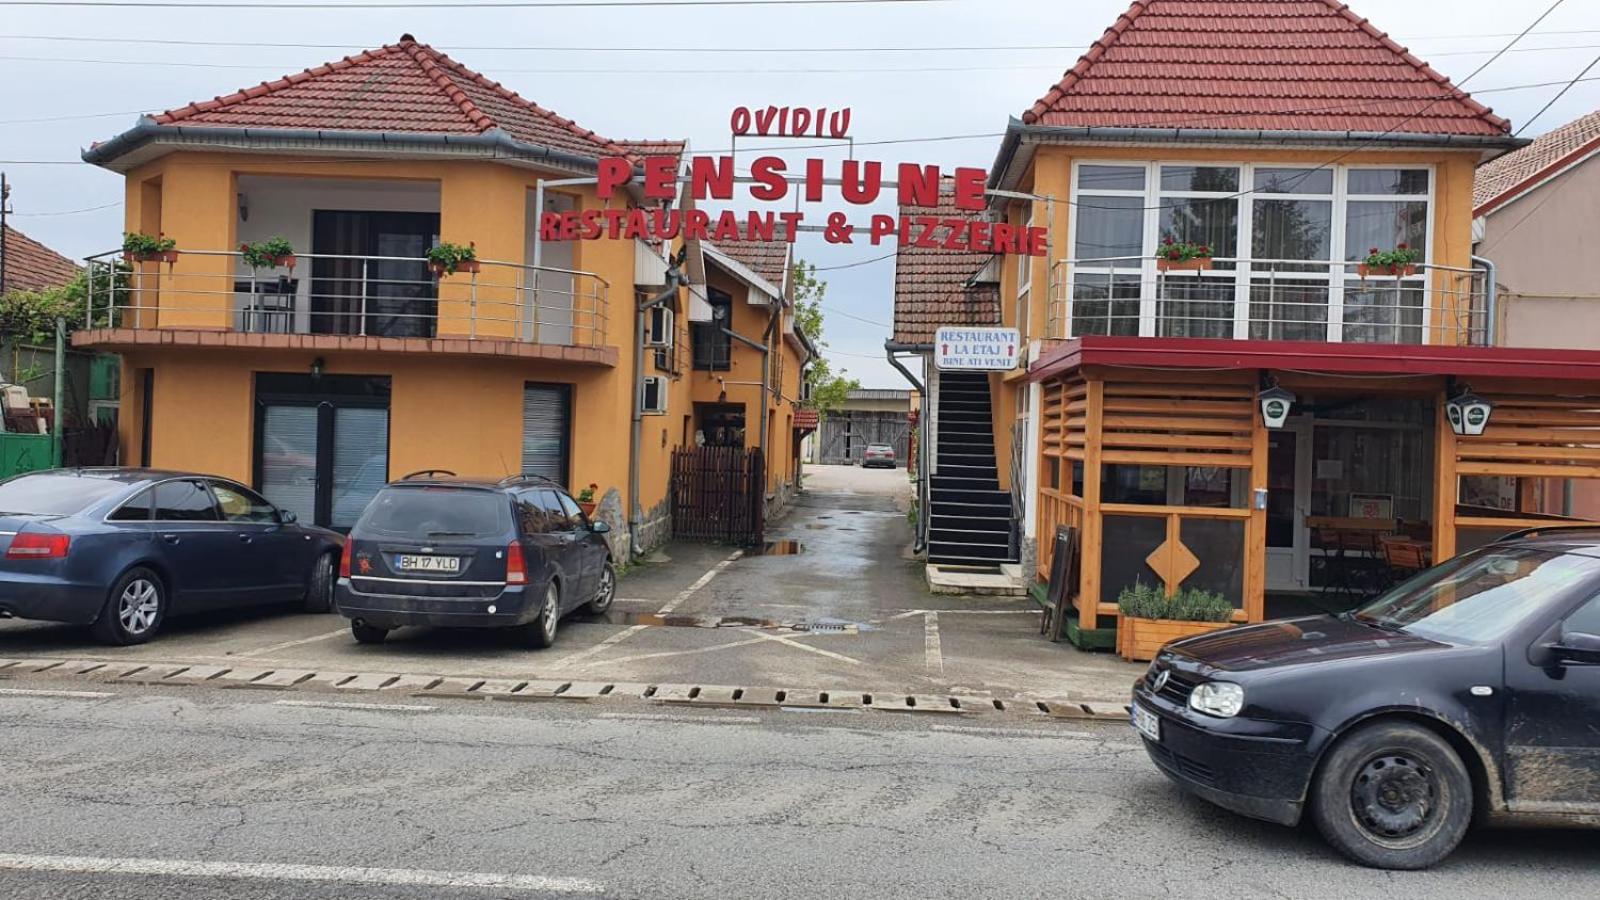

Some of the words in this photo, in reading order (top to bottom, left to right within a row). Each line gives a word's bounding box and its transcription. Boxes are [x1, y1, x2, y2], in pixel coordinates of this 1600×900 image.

[730, 105, 851, 138] OVIDIU
[596, 155, 988, 212] PENSIUNE
[540, 208, 804, 243] RESTAURANT
[824, 211, 854, 244] &
[870, 214, 1048, 257] PIZZERIE
[941, 332, 1015, 342] RESTAURANT
[955, 345, 969, 355] LA
[973, 345, 1000, 355] ETAJ
[943, 358, 963, 366] BINE
[401, 556, 418, 568] BH
[421, 557, 431, 568] 17
[435, 558, 457, 569] YLD
